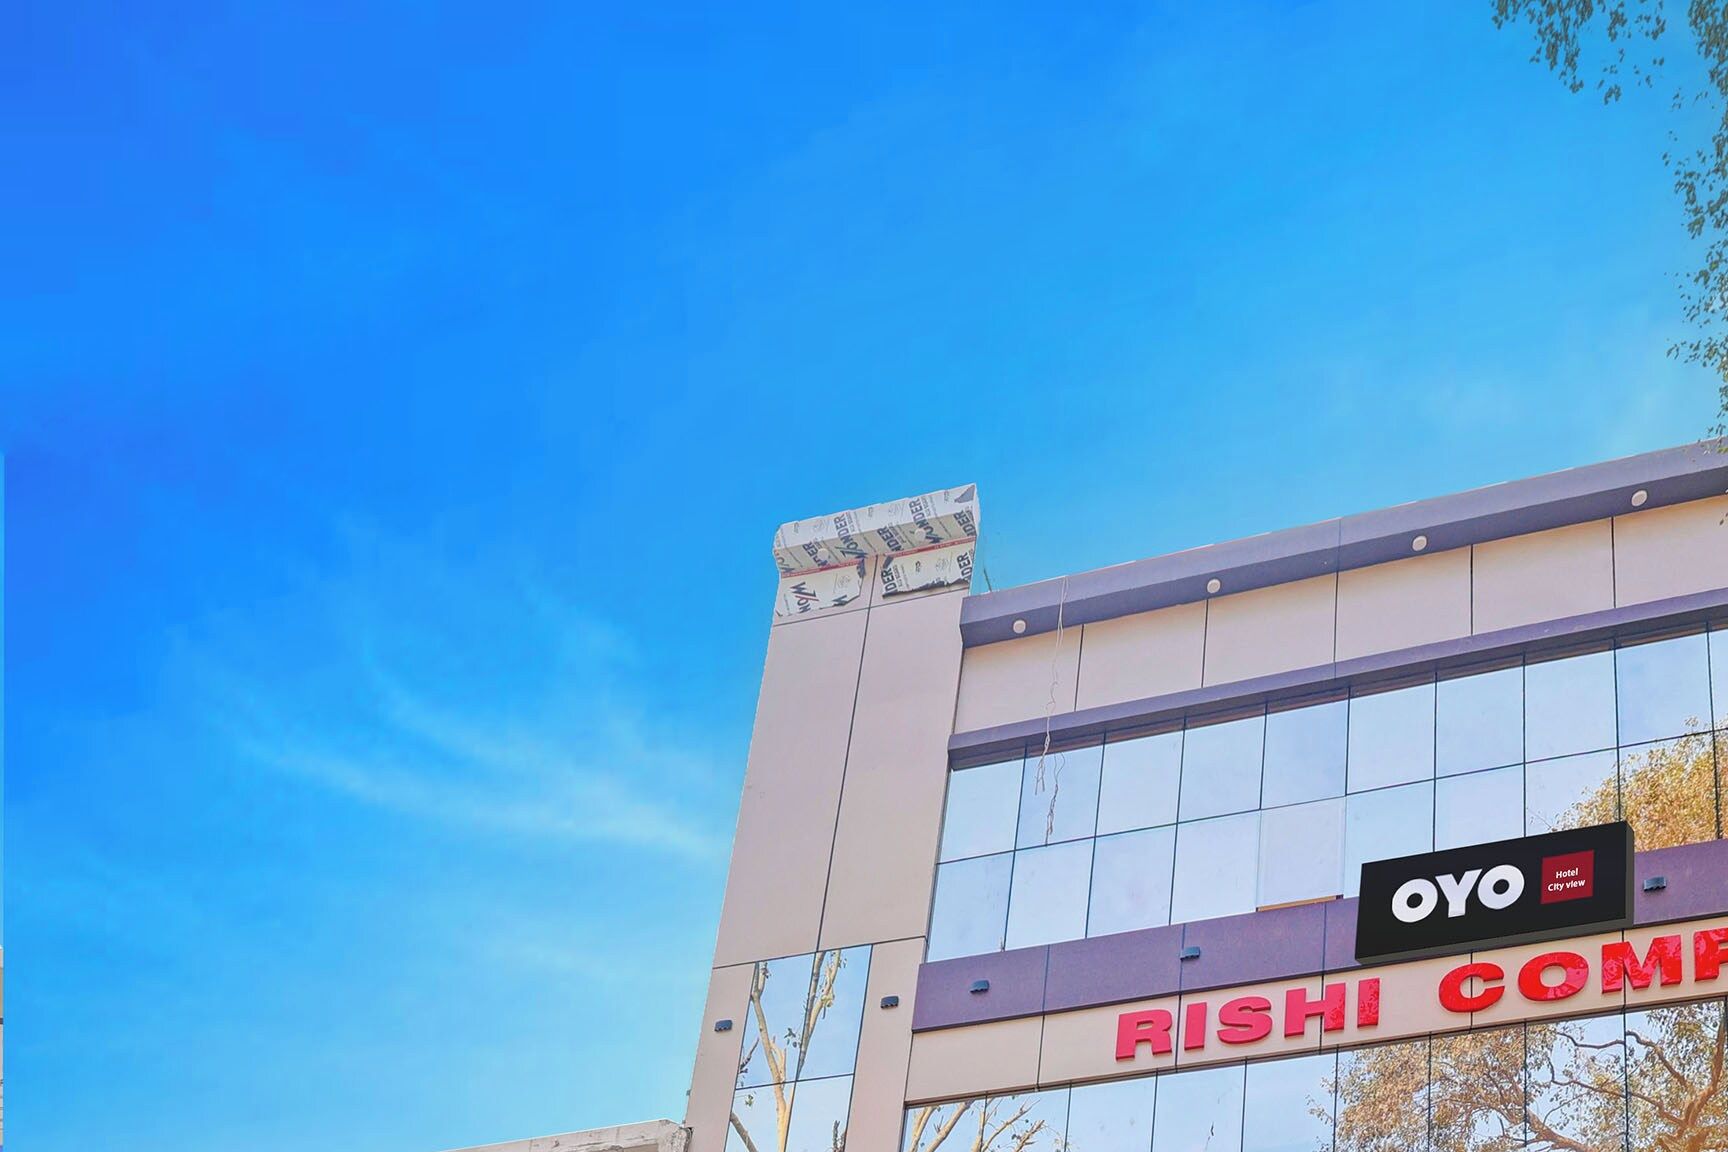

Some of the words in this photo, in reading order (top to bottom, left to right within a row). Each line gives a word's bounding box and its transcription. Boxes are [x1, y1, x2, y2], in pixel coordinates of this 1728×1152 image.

[1548, 881, 1565, 892] City
[1566, 878, 1586, 889] view
[1555, 867, 1579, 879] Hotel
[1392, 864, 1525, 923] OYO
[1115, 976, 1382, 1062] RISHI
